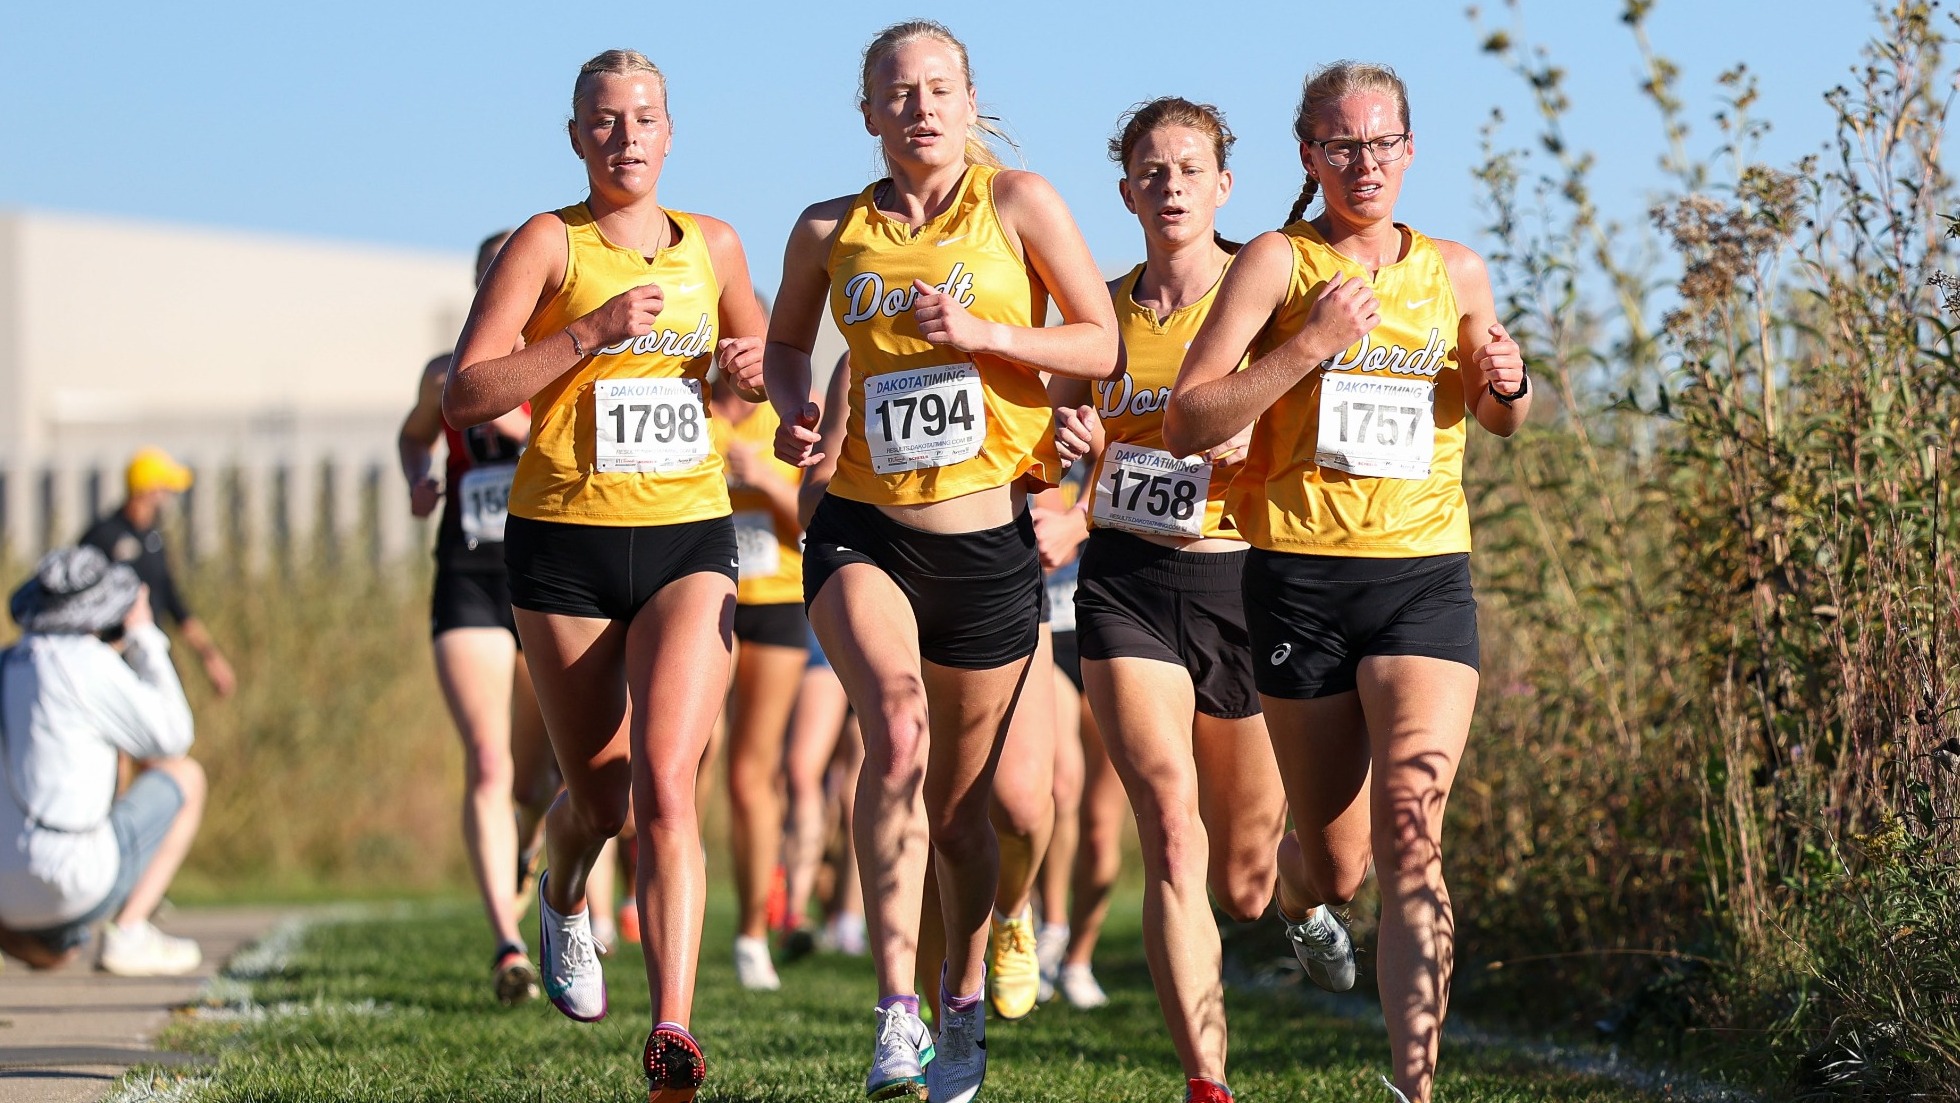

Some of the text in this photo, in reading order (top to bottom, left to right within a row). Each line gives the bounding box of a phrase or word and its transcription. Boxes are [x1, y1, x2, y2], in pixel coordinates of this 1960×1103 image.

[877, 369, 966, 394] DAKOTATIMING
[1098, 372, 1173, 419] Dor
[608, 403, 700, 443] 1798
[875, 389, 975, 442] 1794
[1333, 400, 1423, 447] 1757
[1115, 450, 1199, 474] DAKOTATIMING
[1110, 468, 1197, 521] 1758
